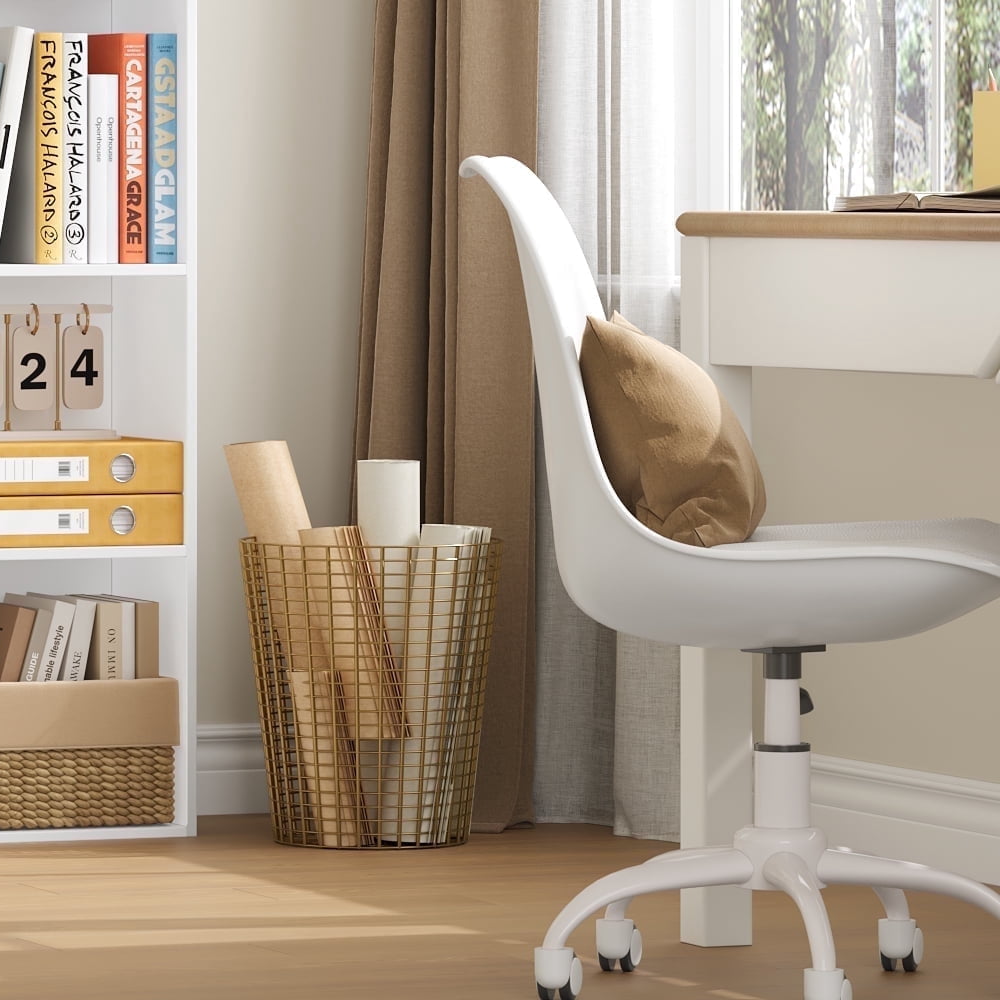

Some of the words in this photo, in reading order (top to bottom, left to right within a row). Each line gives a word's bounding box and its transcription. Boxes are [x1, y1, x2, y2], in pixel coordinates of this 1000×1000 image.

[40, 40, 58, 138] FRANÇOIS
[63, 40, 83, 137] FRANÇOIS
[95, 117, 103, 162] Openhouse
[107, 117, 115, 162] Openhouse
[20, 352, 47, 390] 2
[70, 348, 98, 386] 4
[48, 625, 64, 658] lifestyle
[107, 628, 116, 643] ON
[25, 650, 39, 681] GUIDE
